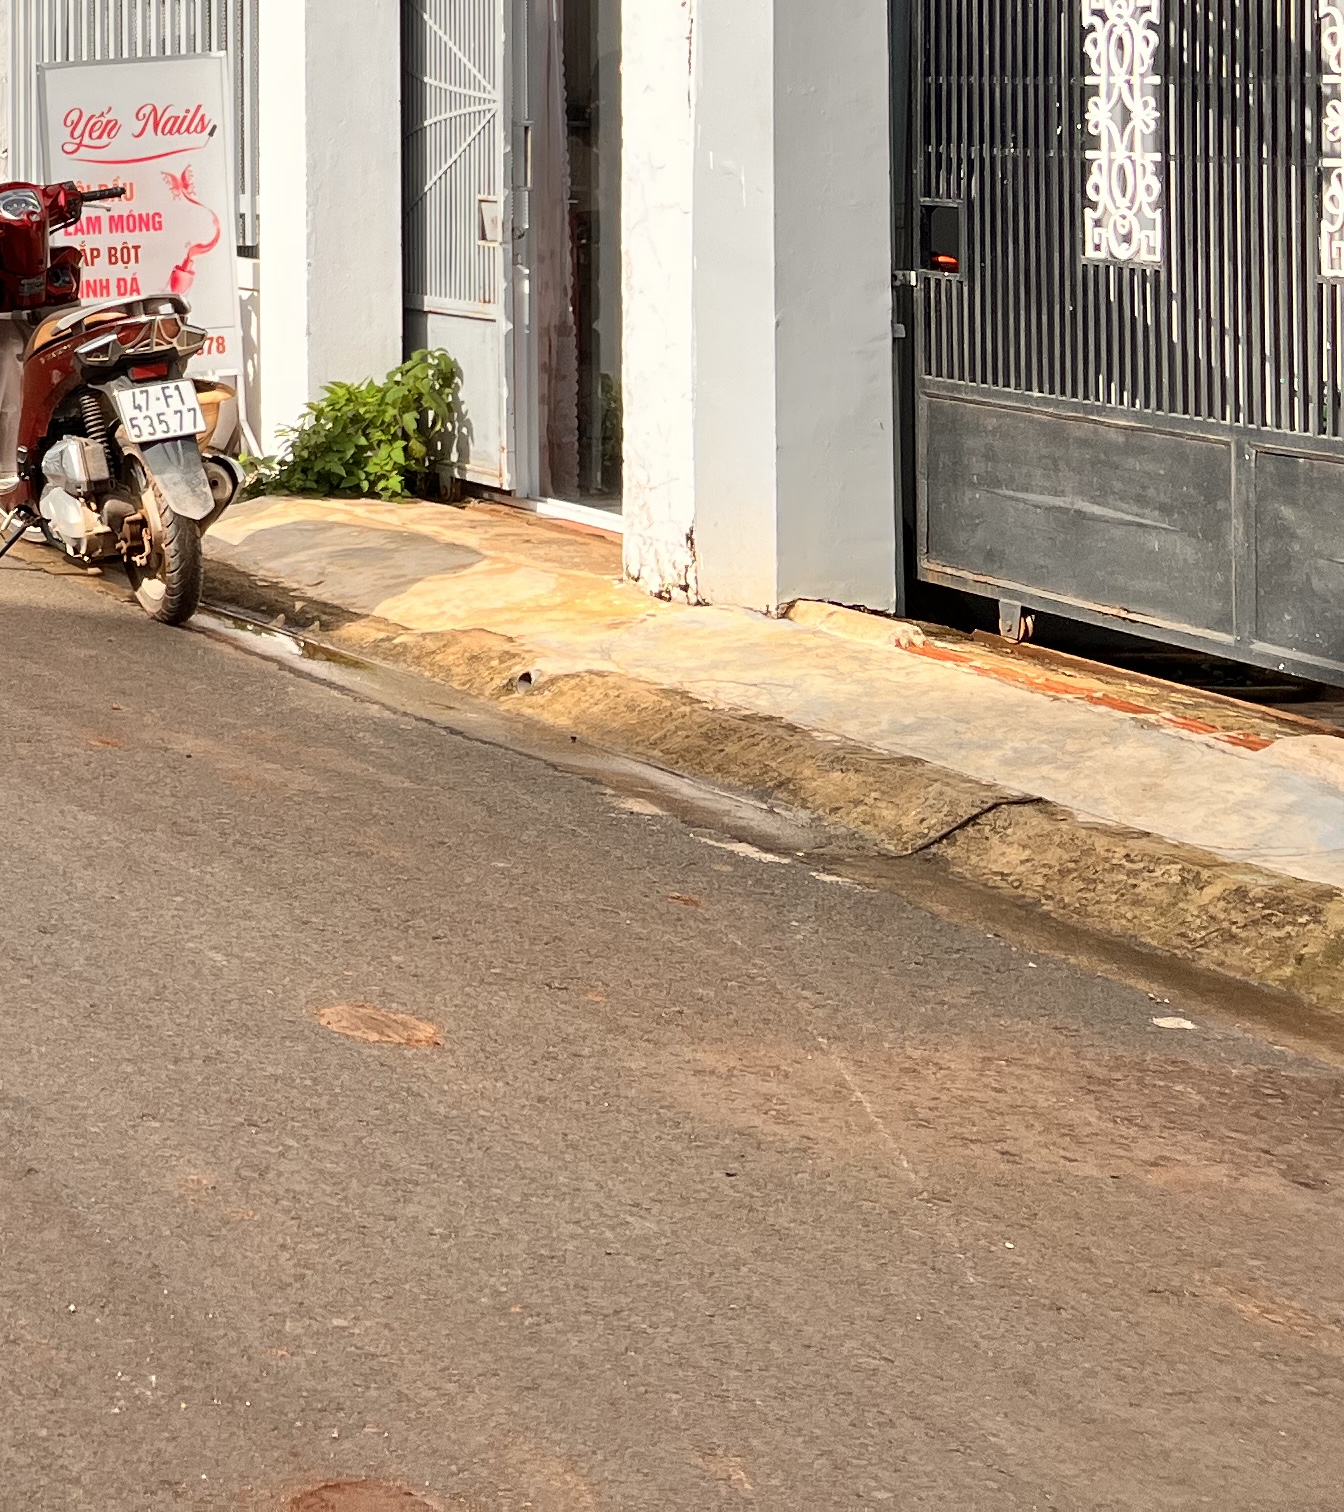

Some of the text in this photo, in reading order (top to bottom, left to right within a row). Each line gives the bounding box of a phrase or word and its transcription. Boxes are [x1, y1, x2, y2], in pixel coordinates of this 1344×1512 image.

[62, 102, 211, 155] Yến Nails
[109, 210, 163, 234] MÓNG
[107, 241, 142, 269] BỘT
[116, 274, 141, 297] ĐÁ
[131, 384, 186, 413] 47-F1
[129, 407, 197, 439] 535.77
